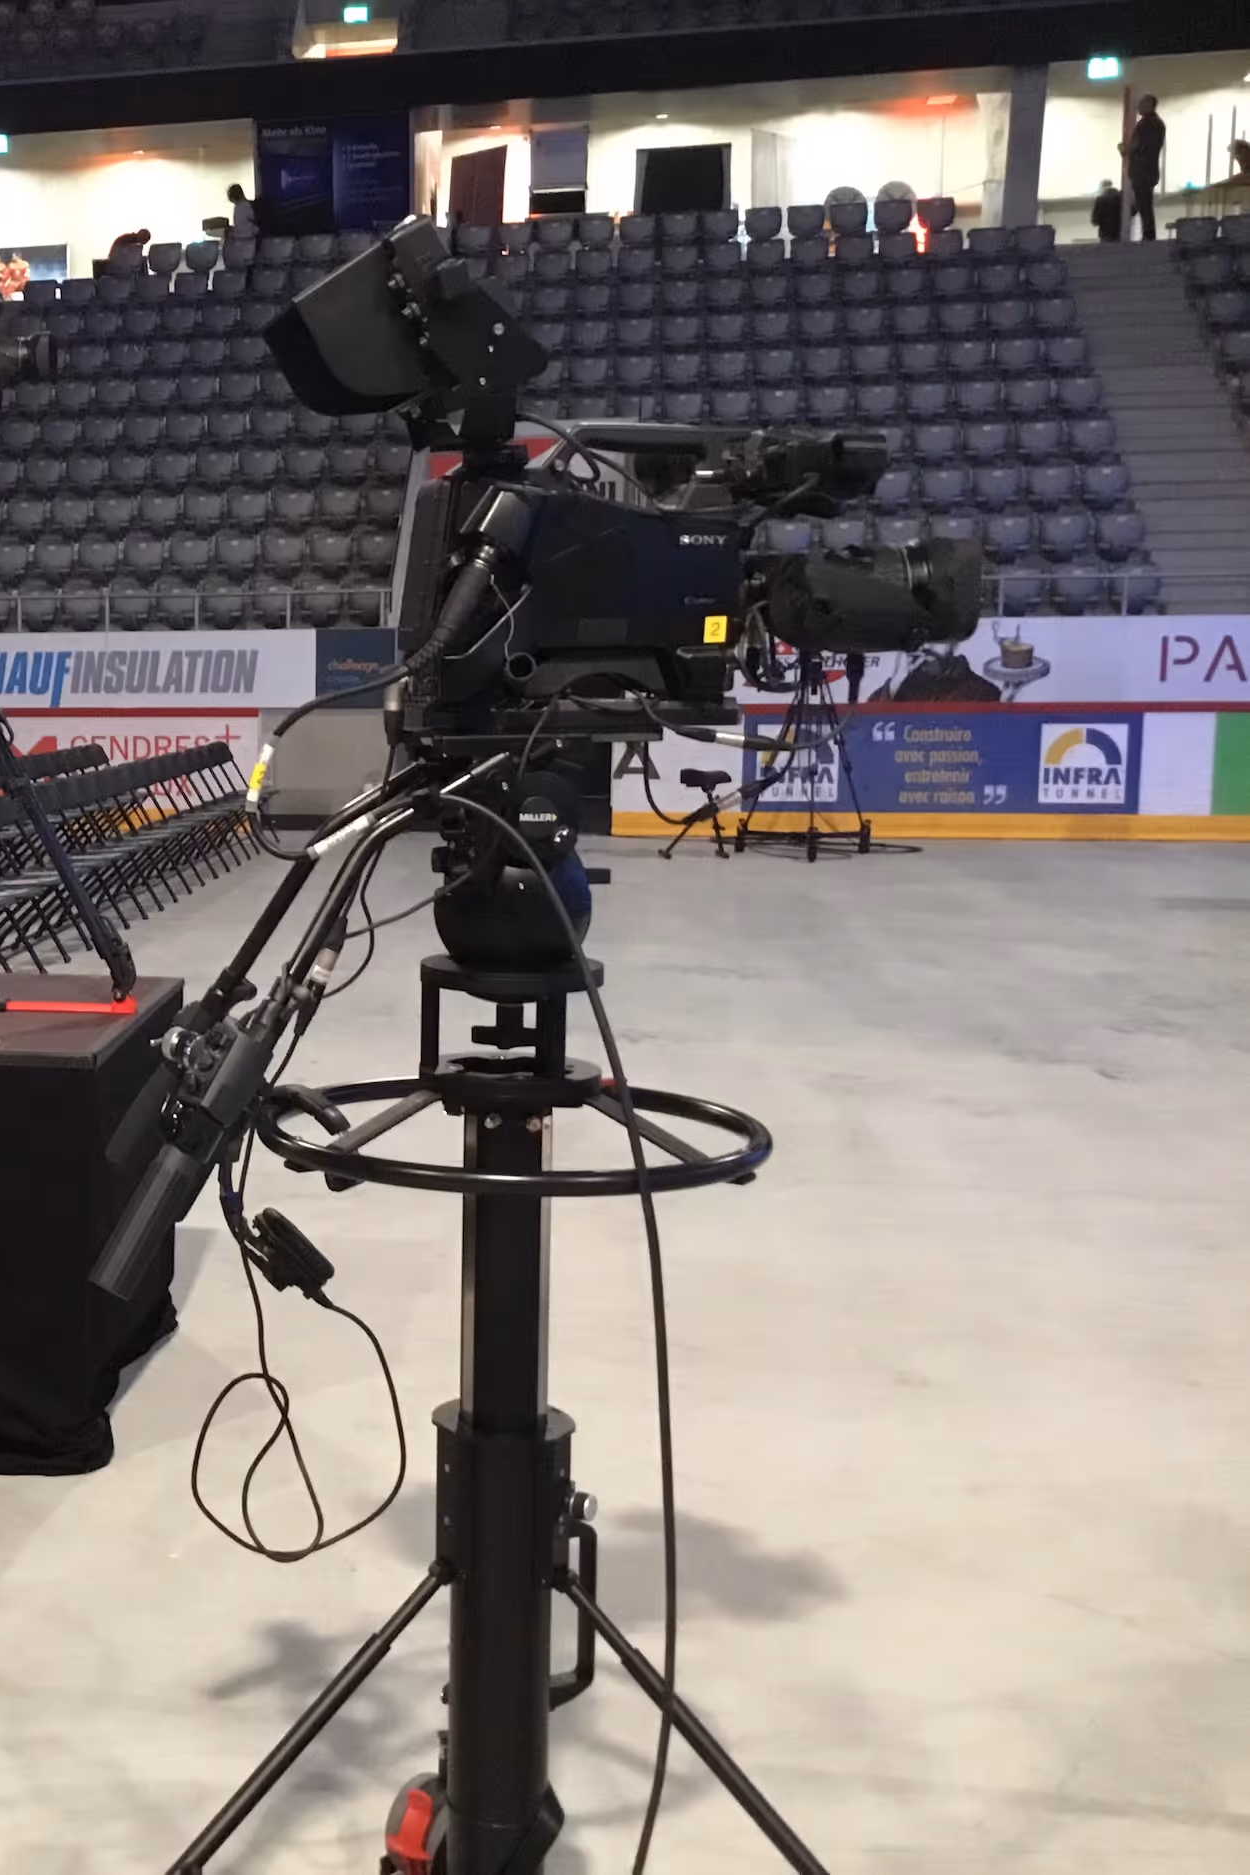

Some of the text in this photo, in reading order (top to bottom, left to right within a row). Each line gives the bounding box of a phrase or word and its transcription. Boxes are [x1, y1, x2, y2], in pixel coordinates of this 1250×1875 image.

[679, 534, 727, 546] SONY
[710, 622, 721, 637] 2
[1159, 634, 1248, 682] PA
[70, 649, 258, 694] INSULATION
[903, 724, 973, 742] Construire
[894, 750, 925, 763] avec
[904, 768, 970, 784] entretenir
[1043, 767, 1122, 785] INFRA
[760, 786, 834, 798] UNNEL
[898, 787, 976, 804] avec raison
[1043, 787, 1121, 800] TUNNEL
[519, 812, 552, 822] MILLER
